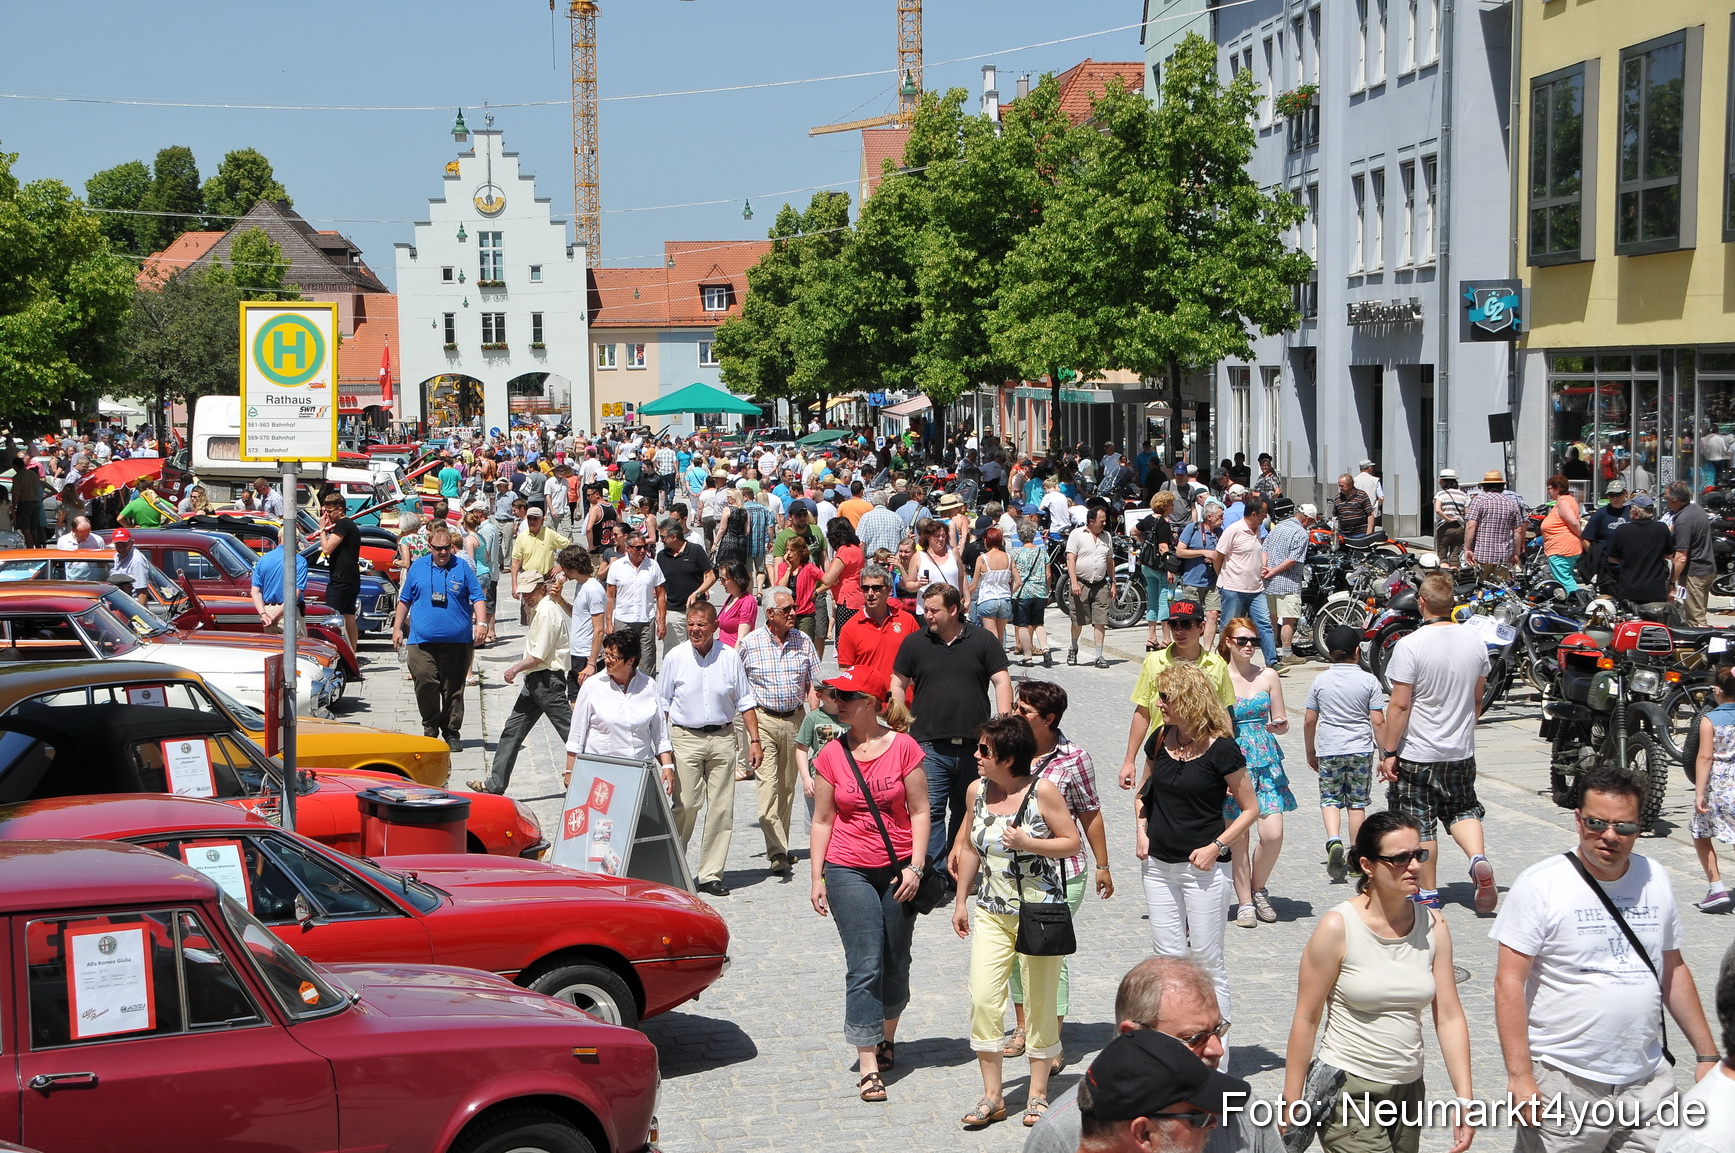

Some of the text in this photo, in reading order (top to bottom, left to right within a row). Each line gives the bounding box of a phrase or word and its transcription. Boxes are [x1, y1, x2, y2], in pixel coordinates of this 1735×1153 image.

[1484, 297, 1504, 321] G2
[273, 331, 306, 369] H
[266, 395, 312, 405] Rathaus
[1574, 908, 1604, 922] THE
